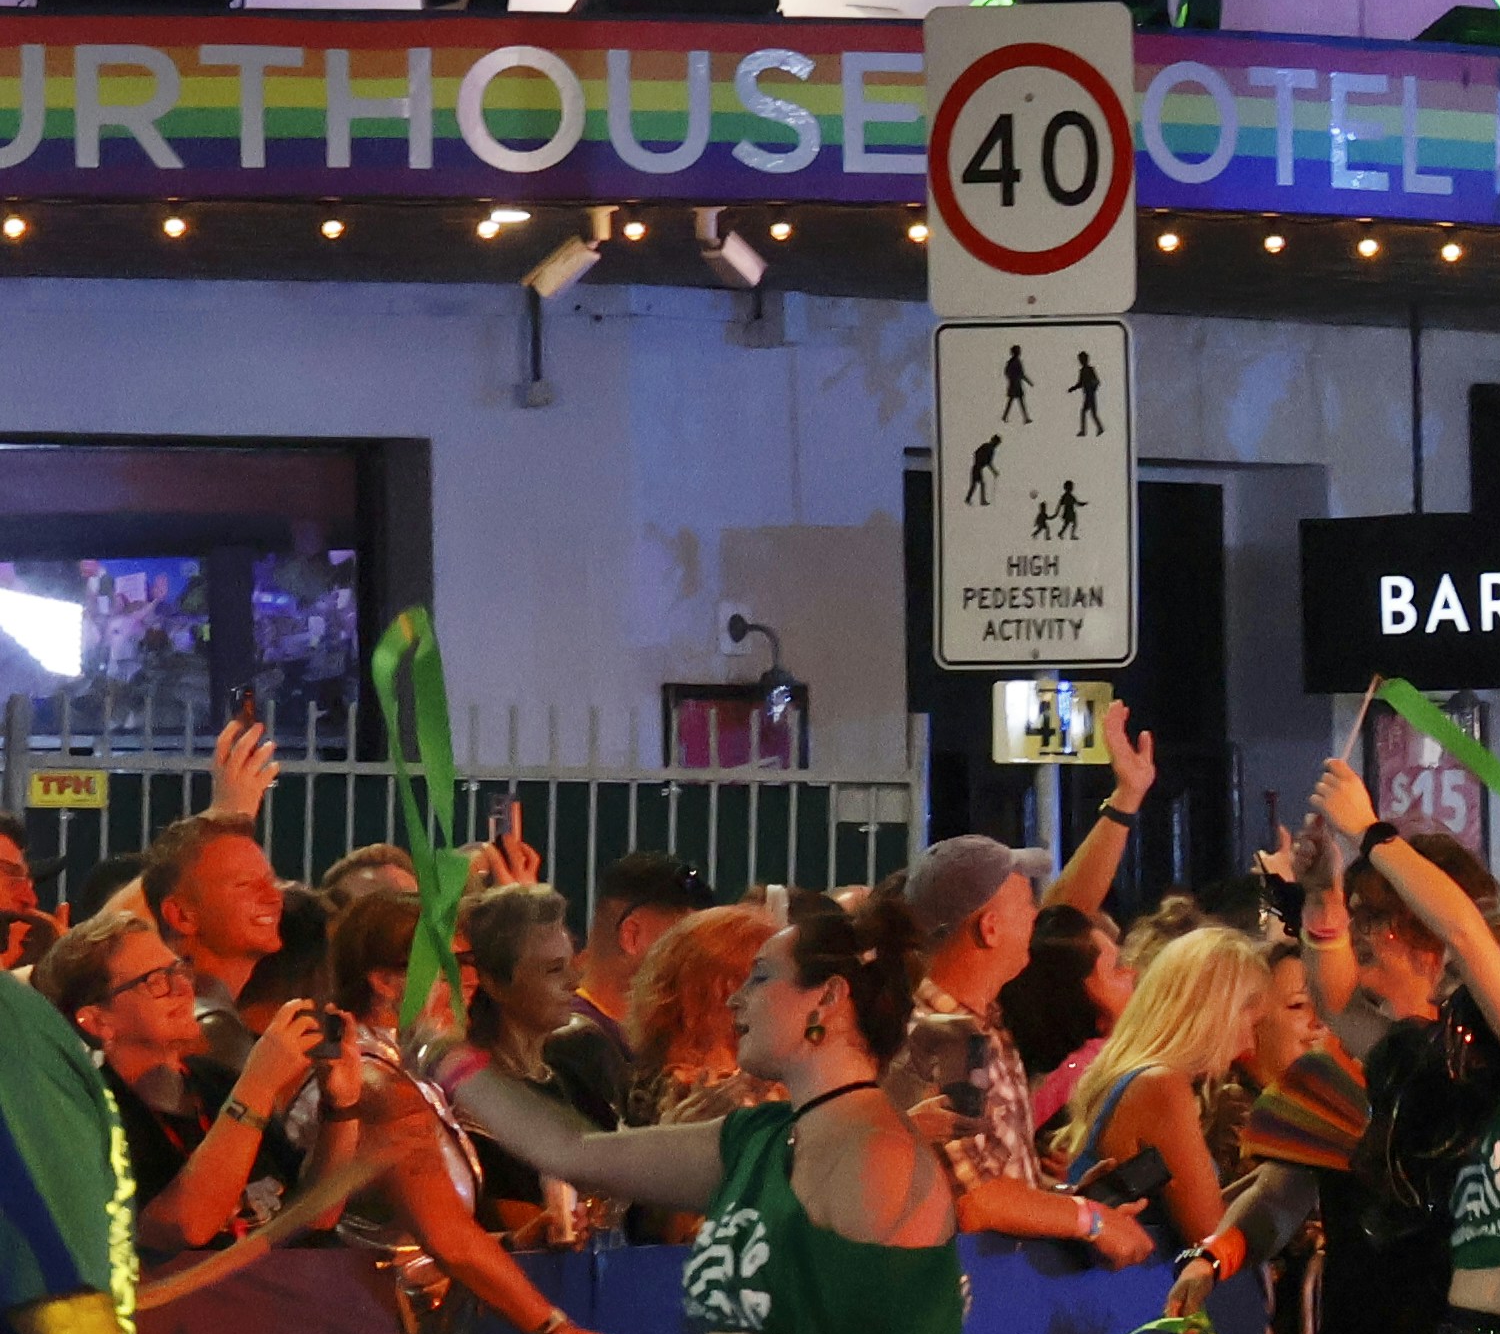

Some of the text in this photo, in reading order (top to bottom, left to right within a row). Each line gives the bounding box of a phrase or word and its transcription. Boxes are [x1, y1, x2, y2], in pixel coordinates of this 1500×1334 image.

[1142, 60, 1454, 195] OTEL
[961, 109, 1100, 208] 40
[1006, 555, 1059, 577] HIGH
[962, 585, 1104, 610] PEDESTRIAN
[982, 618, 1084, 642] ACTIVITY
[1390, 769, 1467, 834] $15
